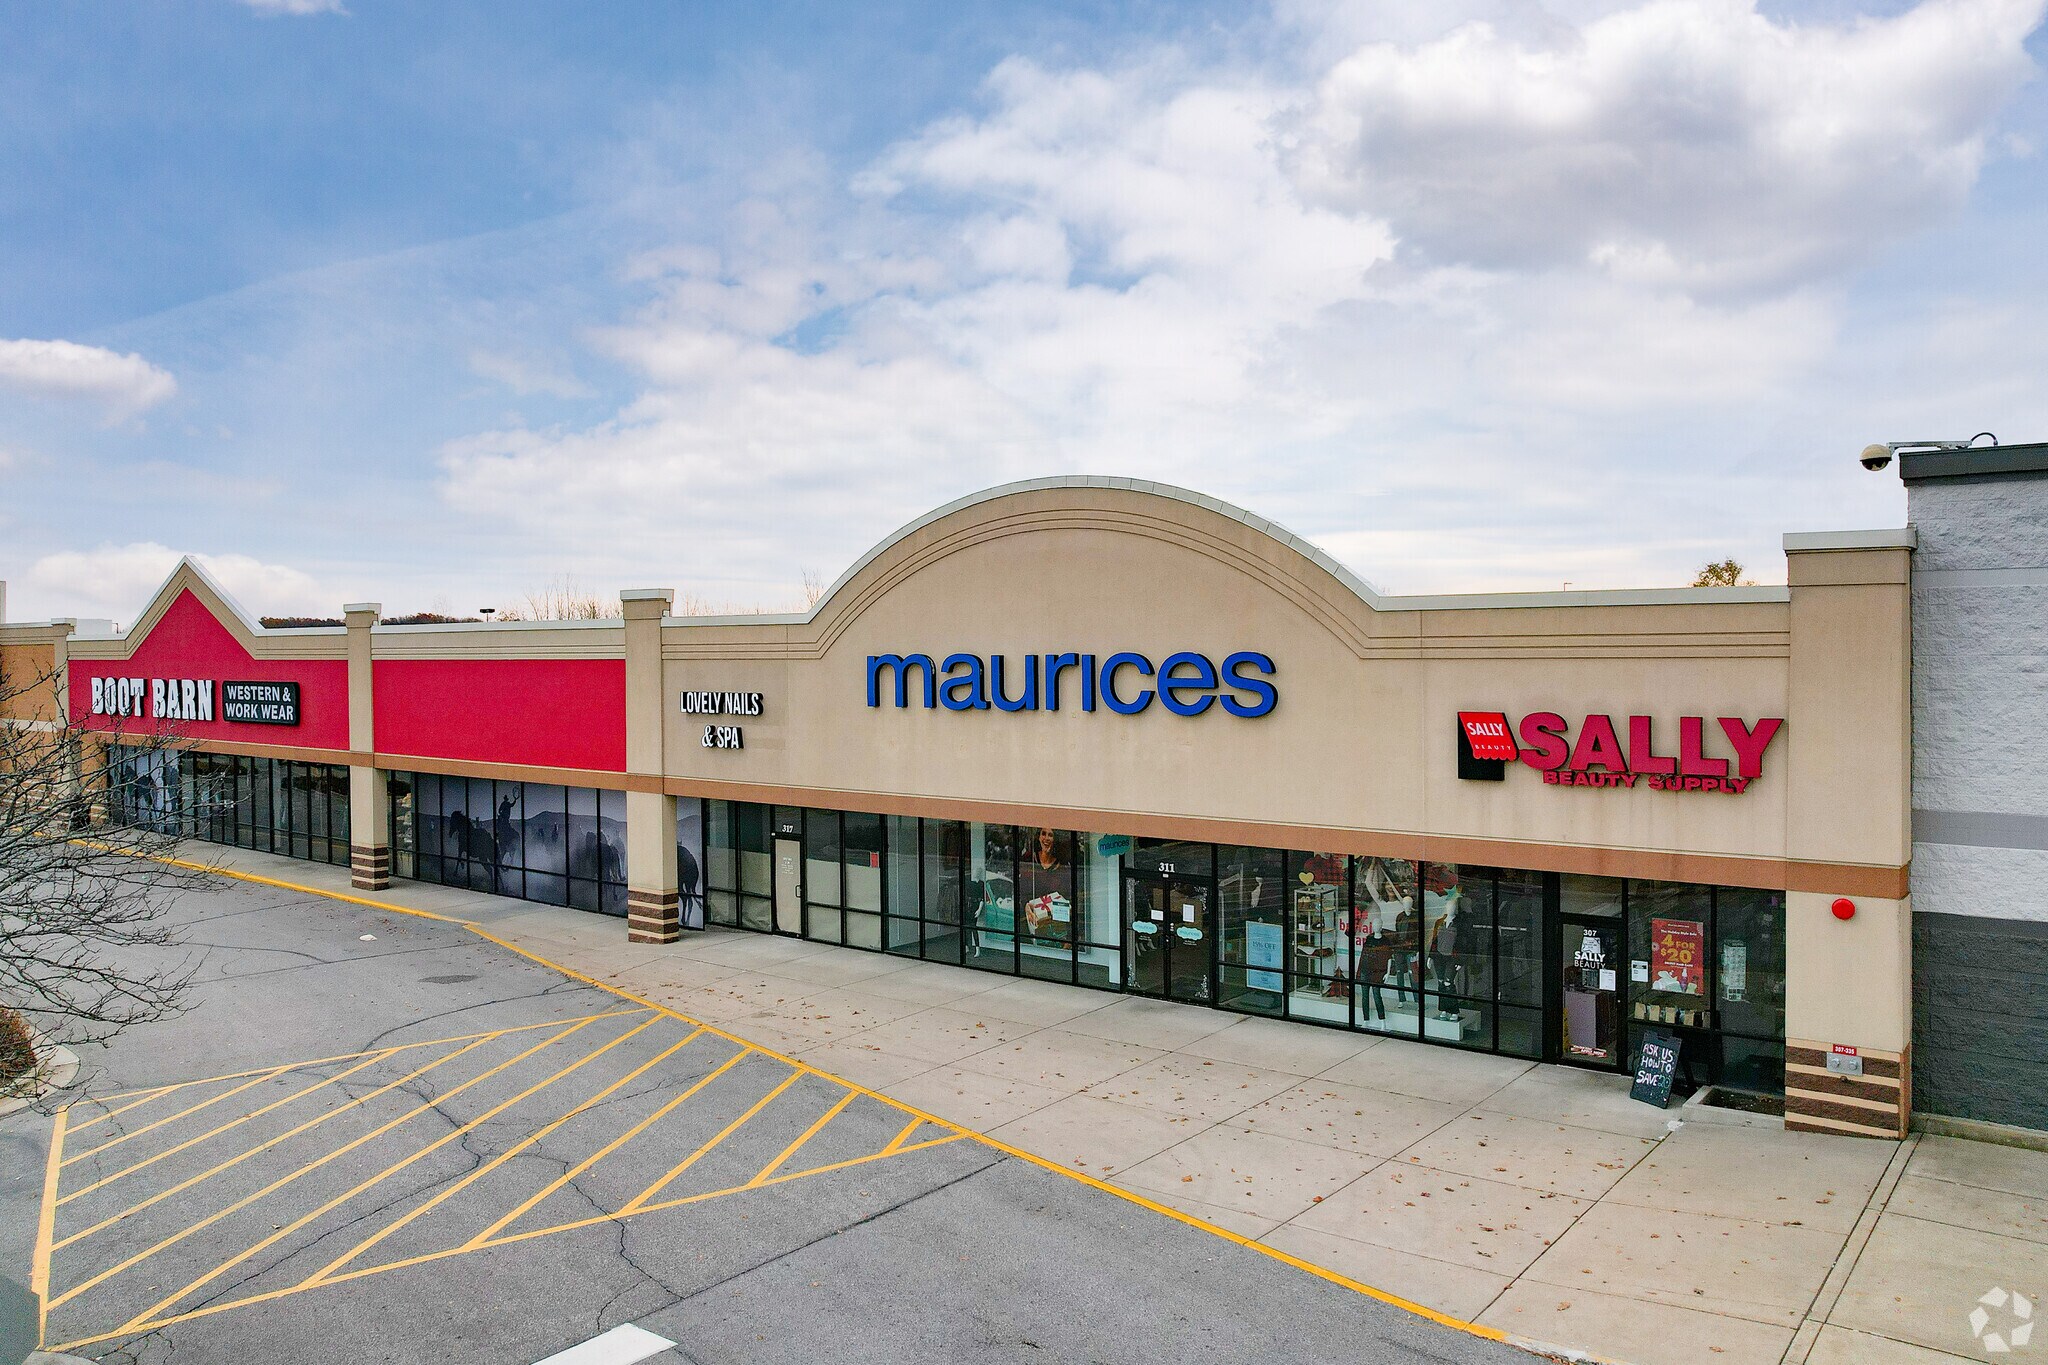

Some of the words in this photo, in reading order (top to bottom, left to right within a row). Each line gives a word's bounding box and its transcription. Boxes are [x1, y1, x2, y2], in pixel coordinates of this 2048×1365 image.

[226, 685, 280, 702] WESTERN
[282, 686, 292, 702] &
[866, 651, 1280, 718] maurices
[91, 677, 145, 717] BOOT
[152, 678, 213, 721] BARN
[680, 691, 722, 714] LOVELY
[724, 692, 761, 716] NAILS
[225, 702, 259, 719] WORK
[260, 704, 294, 721] WEAR
[701, 725, 715, 747] &
[716, 726, 741, 749] SPA
[1466, 722, 1505, 737] SALLY
[1519, 711, 1785, 779] SALLY
[1543, 770, 1638, 789] BEAUTY
[1647, 775, 1750, 795] SUPPLY
[781, 824, 794, 834] 317
[1158, 861, 1176, 873] 311
[1583, 929, 1598, 937] 307
[1661, 934, 1675, 947] 4
[1676, 941, 1696, 950] FOR
[1574, 950, 1606, 963] SALLY
[1574, 960, 1606, 970] BEAUTY
[1642, 1043, 1660, 1057] ASK
[1661, 1047, 1674, 1063] US
[1640, 1055, 1661, 1069] HOW
[1660, 1060, 1672, 1074] TO
[1636, 1070, 1660, 1086] SAVE
